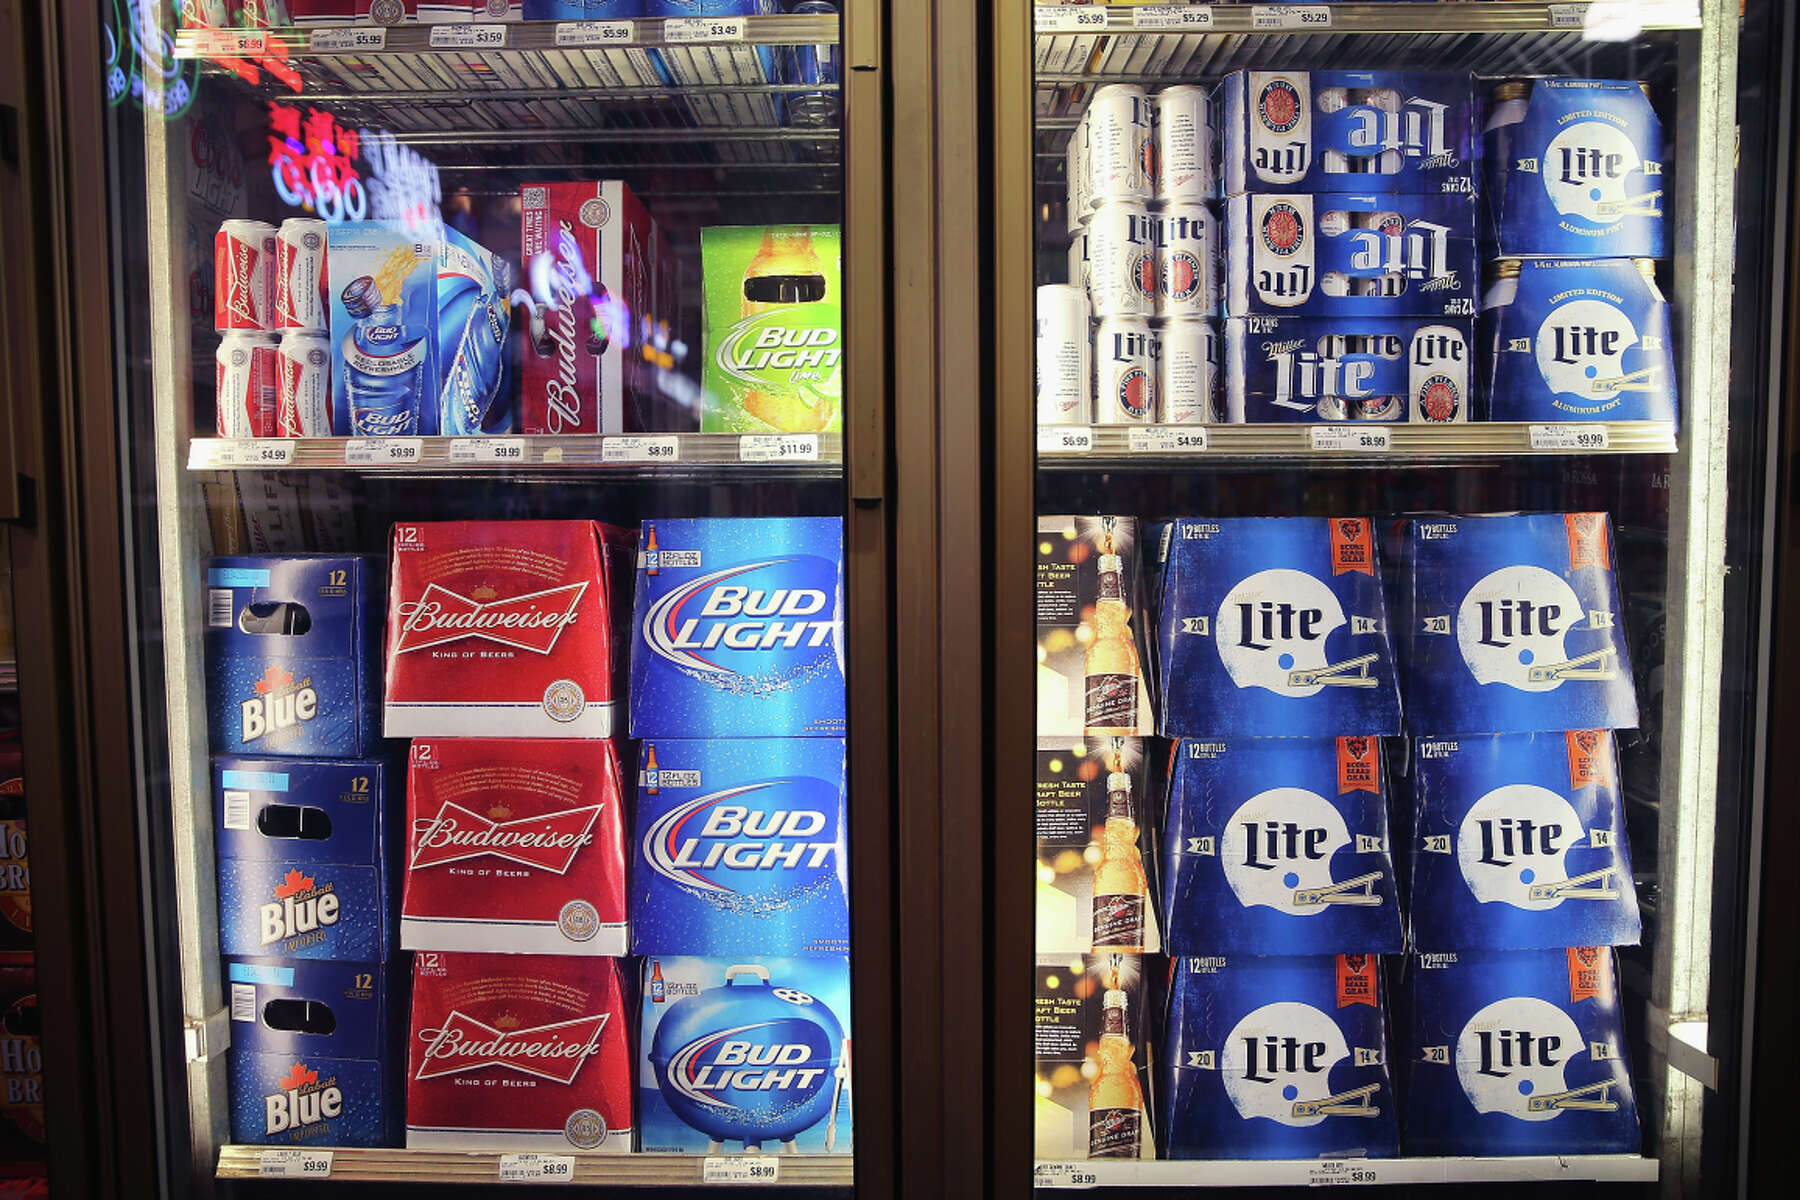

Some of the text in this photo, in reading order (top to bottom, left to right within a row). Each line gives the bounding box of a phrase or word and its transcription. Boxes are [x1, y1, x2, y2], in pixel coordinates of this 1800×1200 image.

[1078, 13, 1104, 24] $5.99
[1183, 13, 1209, 23] $5.29
[1301, 12, 1327, 23] $5.29
[476, 33, 502, 43] $3.59
[603, 28, 629, 39] $5.99
[711, 25, 737, 36] $3.49
[356, 34, 382, 45] $5.99
[1348, 96, 1454, 157] Lite
[1256, 141, 1307, 174] Lite
[1557, 147, 1623, 186] Lite
[1158, 215, 1207, 248] Lite
[1350, 219, 1457, 280] Lite
[1259, 264, 1311, 297] Lite
[1549, 288, 1623, 304] LIMITED EDITION
[546, 219, 581, 435] Budweiser
[1249, 318, 1260, 334] 12
[755, 326, 838, 348] BUD
[1261, 338, 1305, 356] Miller
[1414, 335, 1463, 366] Lite
[1551, 326, 1619, 365] Lite
[737, 350, 841, 371] LIGHT
[1265, 352, 1376, 413] Lite
[366, 410, 410, 425] BUD
[1177, 437, 1203, 446] $4.99
[1360, 437, 1385, 447] $8.99
[1577, 434, 1603, 445] $9.99
[261, 450, 286, 460] $4.99
[390, 448, 415, 458] $9.99
[495, 447, 520, 457] $9.99
[648, 446, 673, 457] $8.99
[398, 528, 417, 542] 12
[1181, 525, 1194, 540] 12
[1420, 525, 1432, 540] 12
[646, 553, 658, 564] 12
[329, 570, 347, 586] 12
[700, 585, 826, 617] BUD
[398, 601, 579, 632] Budweiser
[1475, 600, 1561, 648] Lite
[1595, 614, 1606, 625] 14
[1190, 619, 1204, 632] 20
[1235, 601, 1323, 651] Lite
[1357, 619, 1368, 631] 14
[1432, 619, 1446, 631] 20
[671, 618, 838, 651] LIGHT
[242, 687, 318, 744] Blue
[411, 745, 431, 760] 12
[1188, 743, 1200, 759] 12
[1421, 743, 1433, 758] 12
[351, 777, 370, 793] 12
[646, 772, 658, 784] 12
[1062, 781, 1086, 789] TASTE
[700, 806, 826, 838] BUD
[413, 818, 594, 849] Budweiser
[1596, 833, 1607, 845] 14
[1197, 839, 1209, 852] 20
[1240, 822, 1328, 871] Lite
[1362, 838, 1373, 850] 14
[1433, 838, 1446, 850] 20
[1476, 818, 1562, 867] Lite
[671, 838, 838, 870] LIGHT
[259, 892, 340, 947] Blue
[418, 954, 439, 967] 12
[1189, 958, 1200, 973] 12
[1420, 954, 1432, 969] 12
[355, 973, 373, 989] 12
[652, 983, 663, 991] 12
[418, 1028, 600, 1059] Budweiser
[714, 1041, 811, 1066] BUD
[1196, 1053, 1210, 1065] 20
[1360, 1051, 1370, 1062] 14
[1431, 1049, 1444, 1061] 20
[1474, 1030, 1561, 1077] Lite
[1596, 1046, 1608, 1057] 14
[1241, 1036, 1326, 1083] Lite
[454, 1078, 480, 1086] KING
[691, 1066, 825, 1091] LIGHT
[265, 1087, 343, 1136] Blue
[304, 1161, 328, 1172] $9.99
[543, 1164, 568, 1175] $8.99
[750, 1166, 775, 1177] $8.99
[1072, 1174, 1096, 1184] $8.99
[1351, 1172, 1376, 1182] $8.99
